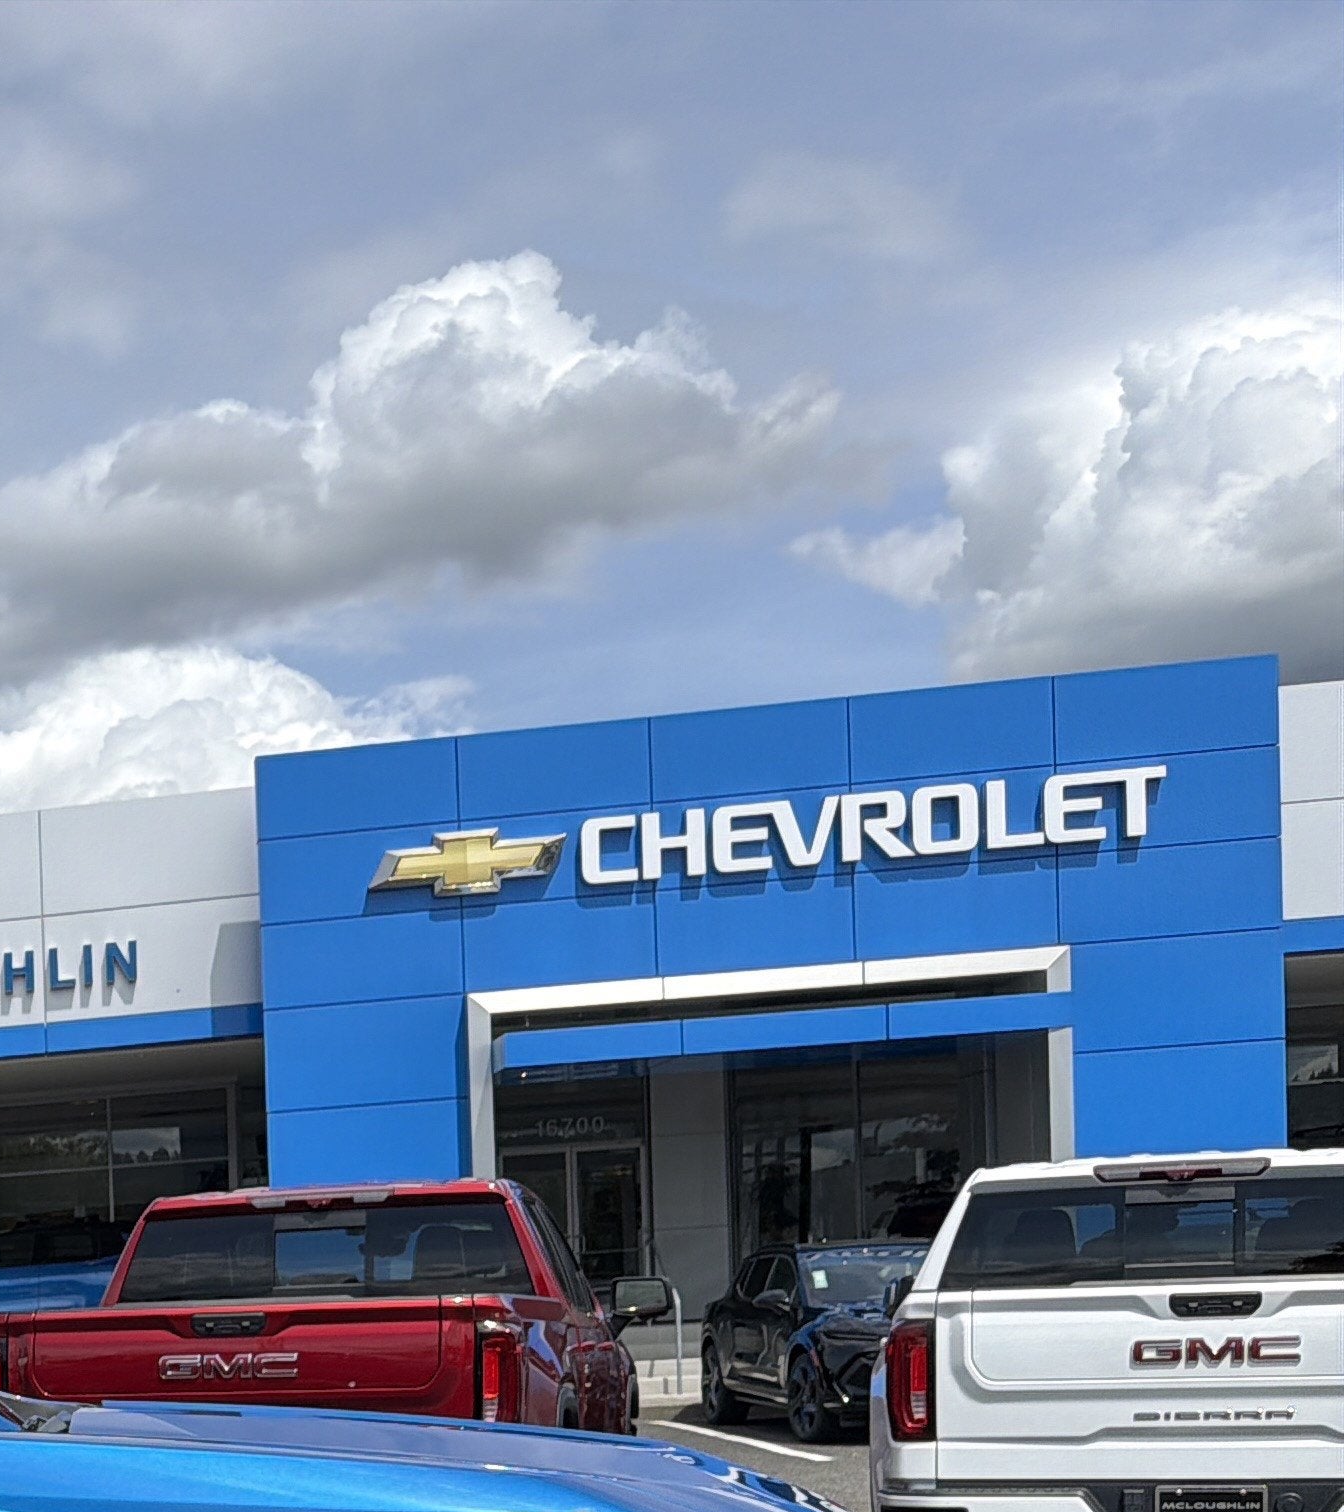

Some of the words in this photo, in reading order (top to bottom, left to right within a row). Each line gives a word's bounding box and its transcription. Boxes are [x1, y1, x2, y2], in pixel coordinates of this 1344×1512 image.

[579, 764, 1168, 886] CHEVROLET
[158, 1352, 298, 1380] GMC
[1130, 1334, 1302, 1370] GMC
[1133, 1410, 1295, 1422] SIERRA
[1161, 1501, 1261, 1510] MCLOUGHLIN
